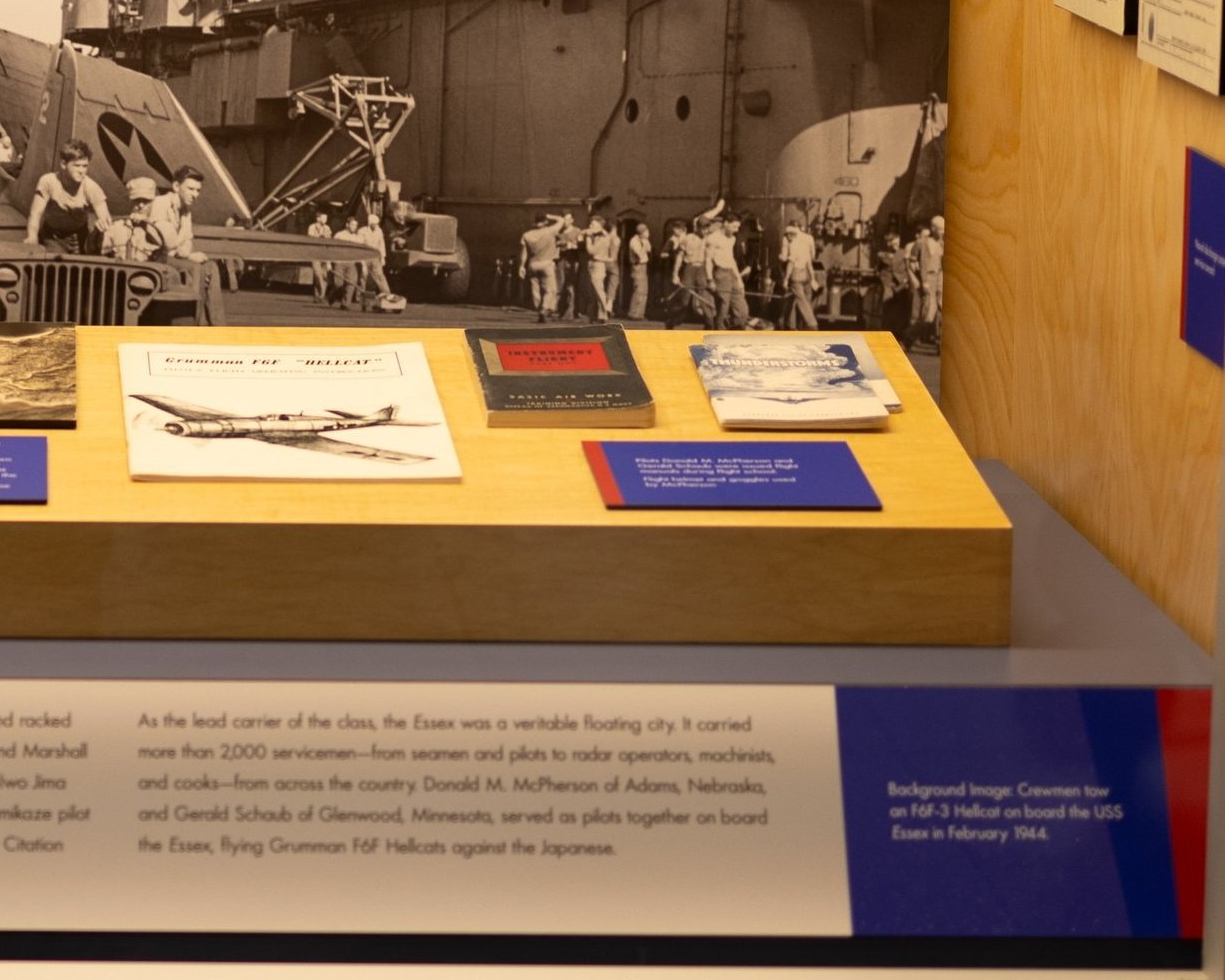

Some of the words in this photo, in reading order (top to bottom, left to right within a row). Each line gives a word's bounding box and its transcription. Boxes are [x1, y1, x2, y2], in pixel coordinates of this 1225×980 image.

[164, 356, 244, 366] Grumman
[709, 358, 841, 368] THUNDERSTORMS
[137, 713, 158, 729] As
[162, 713, 187, 729] the
[191, 712, 227, 729] lead
[231, 716, 282, 729] carrier
[286, 712, 303, 730] of
[307, 713, 332, 730] the
[336, 714, 377, 732] class,
[382, 714, 407, 730] the
[412, 714, 455, 730] Essex
[459, 719, 492, 731] was
[496, 718, 508, 731] a
[512, 715, 578, 731] veritable
[583, 714, 642, 736] floating
[646, 718, 676, 736] city.
[682, 716, 691, 731] It
[696, 716, 752, 732] carried
[887, 782, 966, 799] Background
[969, 783, 1015, 800] Image:
[1017, 782, 1081, 797] Crewmen
[1083, 785, 1109, 798] tow
[889, 807, 907, 818] an
[910, 803, 949, 818] F6F-3
[954, 804, 1000, 818] Hellcat
[1003, 808, 1021, 819] on
[1023, 804, 1065, 819] board
[1068, 805, 1090, 818] the
[1094, 805, 1123, 819] USS
[892, 825, 929, 839] Essex
[931, 827, 944, 839] in
[947, 825, 1008, 842] February
[1014, 825, 1049, 839] 1944.
